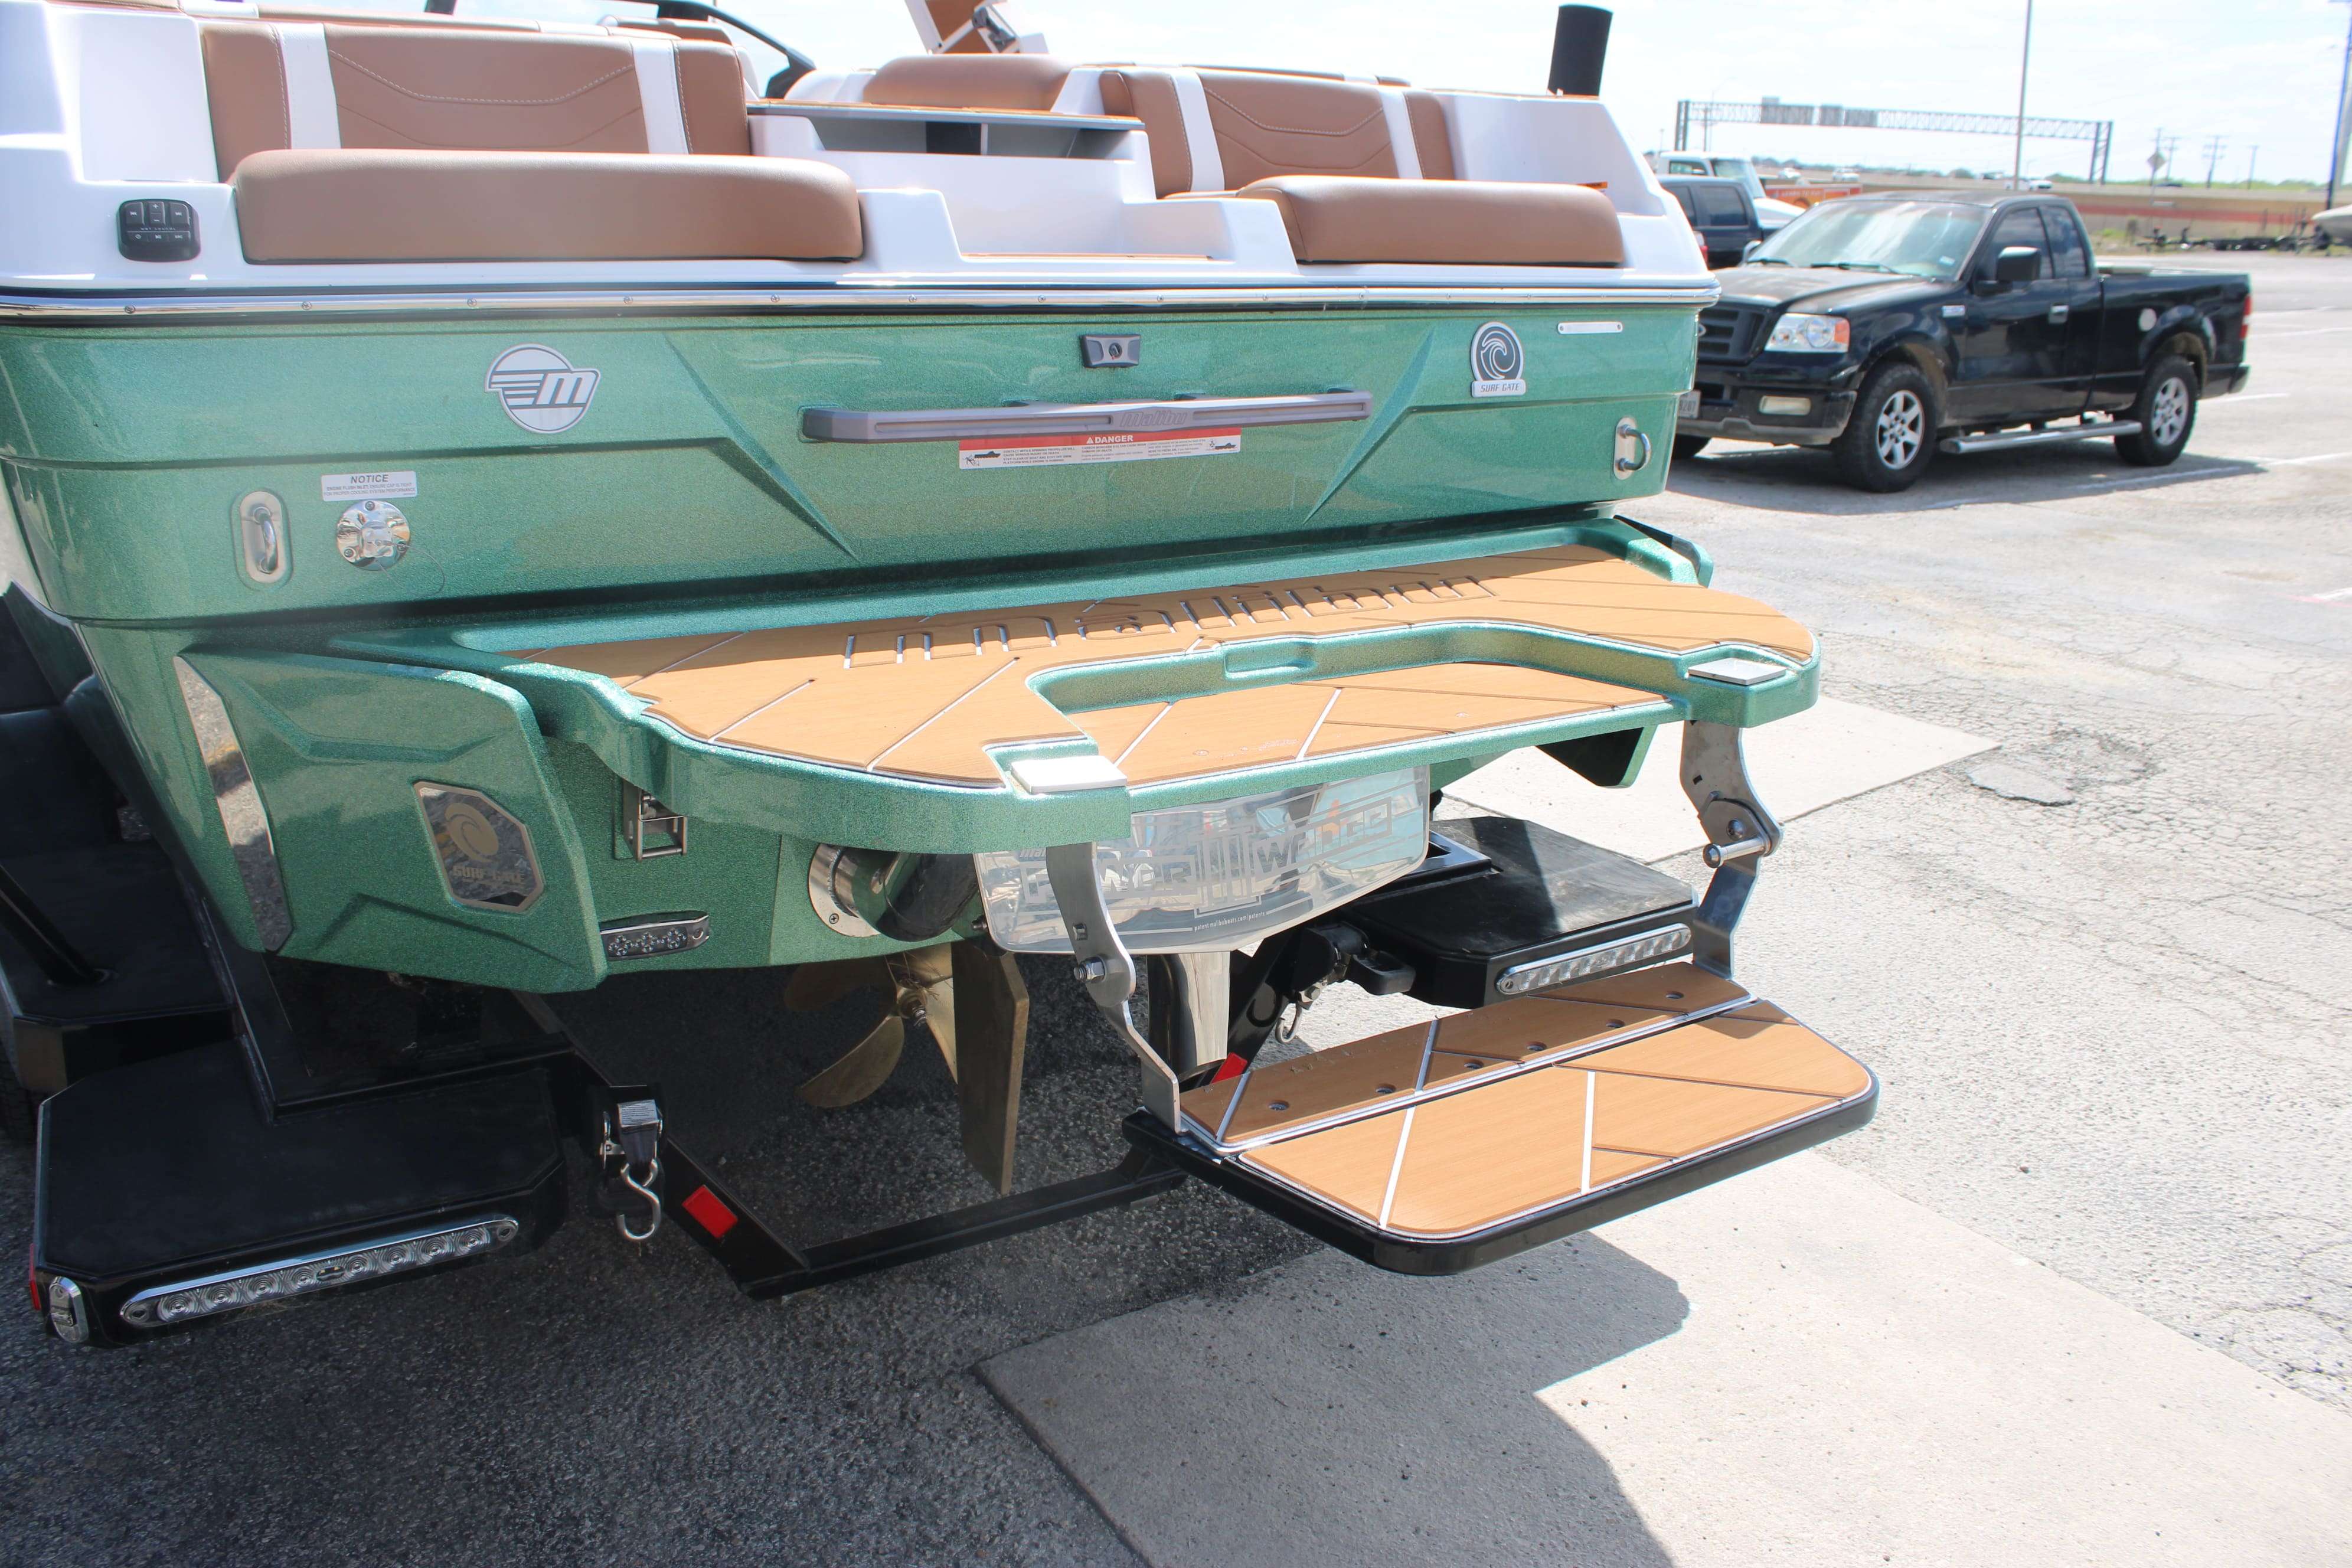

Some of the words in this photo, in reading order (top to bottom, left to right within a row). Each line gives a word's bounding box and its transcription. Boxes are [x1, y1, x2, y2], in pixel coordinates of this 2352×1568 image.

[1481, 384, 1500, 393] SURF
[1502, 383, 1520, 392] GATE
[1095, 435, 1133, 443] DANGER
[351, 474, 388, 484] NOTICE
[1021, 857, 1196, 902] PWER
